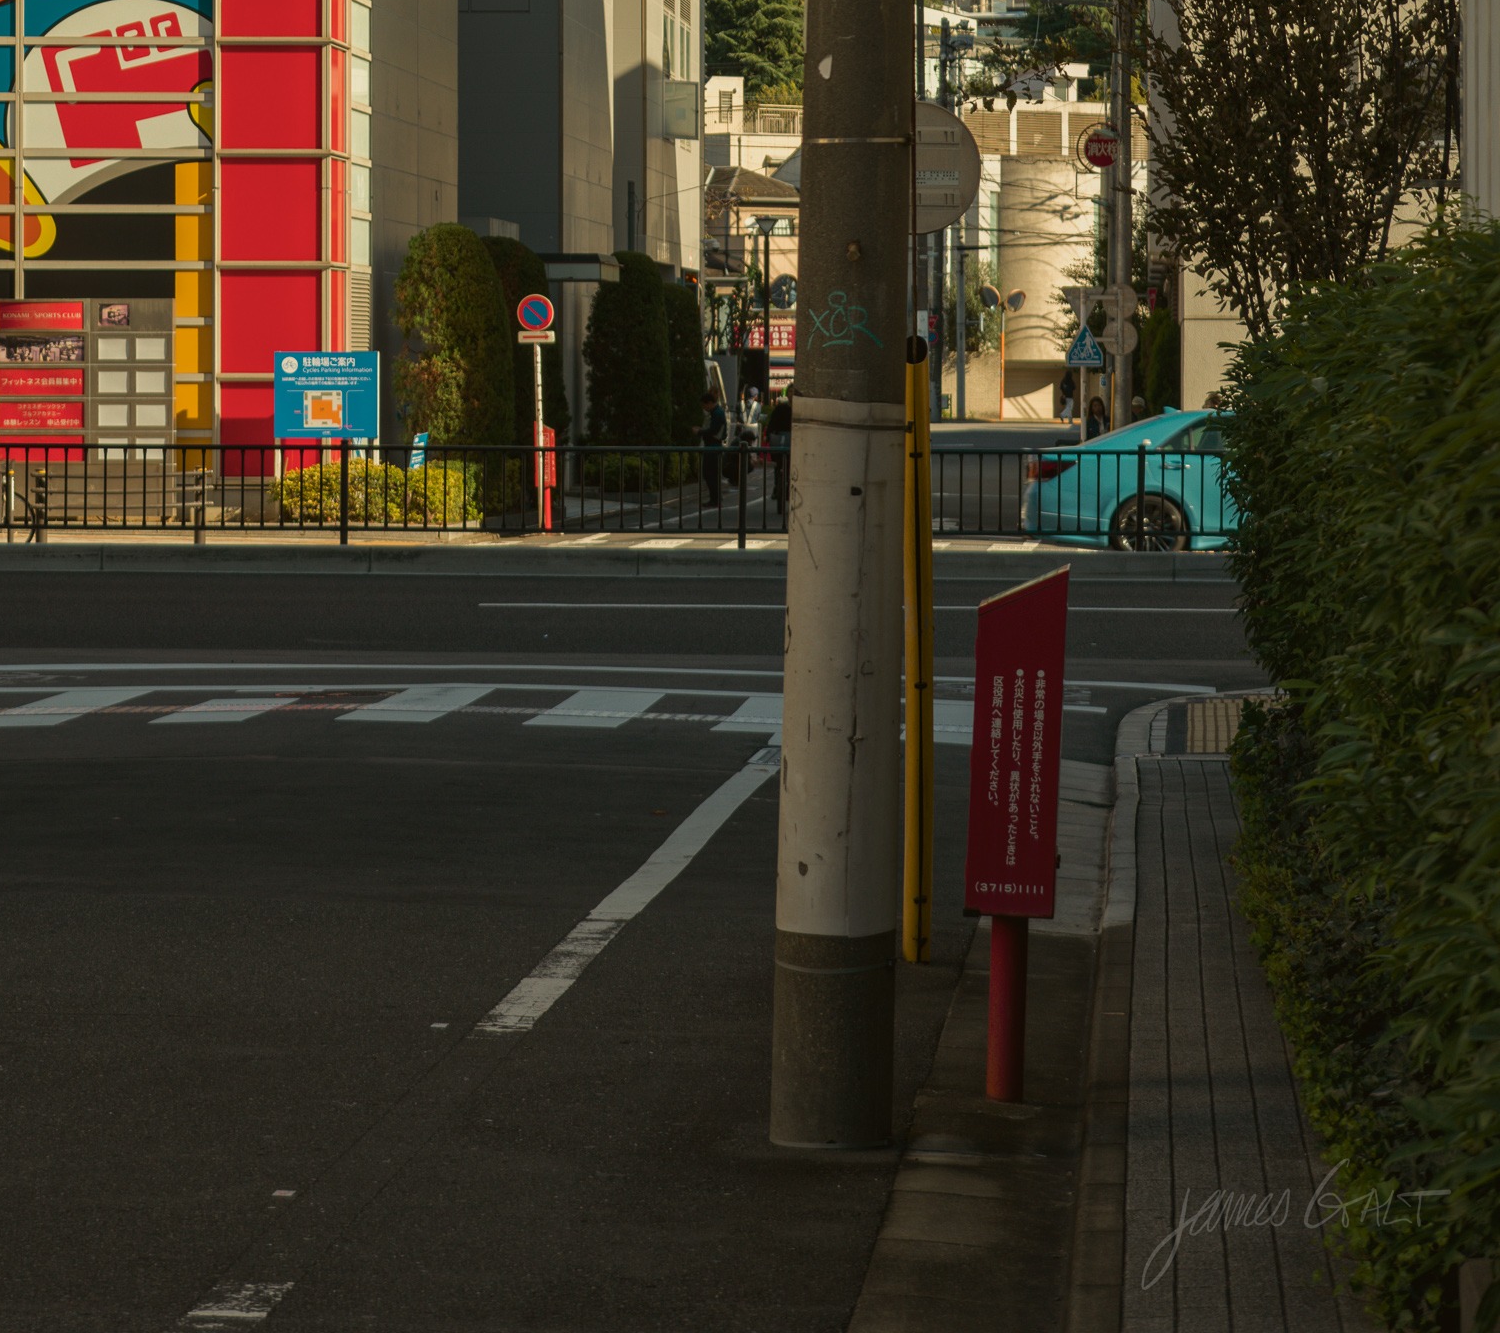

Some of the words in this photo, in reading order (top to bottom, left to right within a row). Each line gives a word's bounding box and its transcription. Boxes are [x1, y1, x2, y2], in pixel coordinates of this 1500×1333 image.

[302, 356, 356, 367] 駐輪場ご案内
[987, 675, 1005, 807] 区役所へ連絡してください。
[974, 881, 1045, 896] (3715)1111
